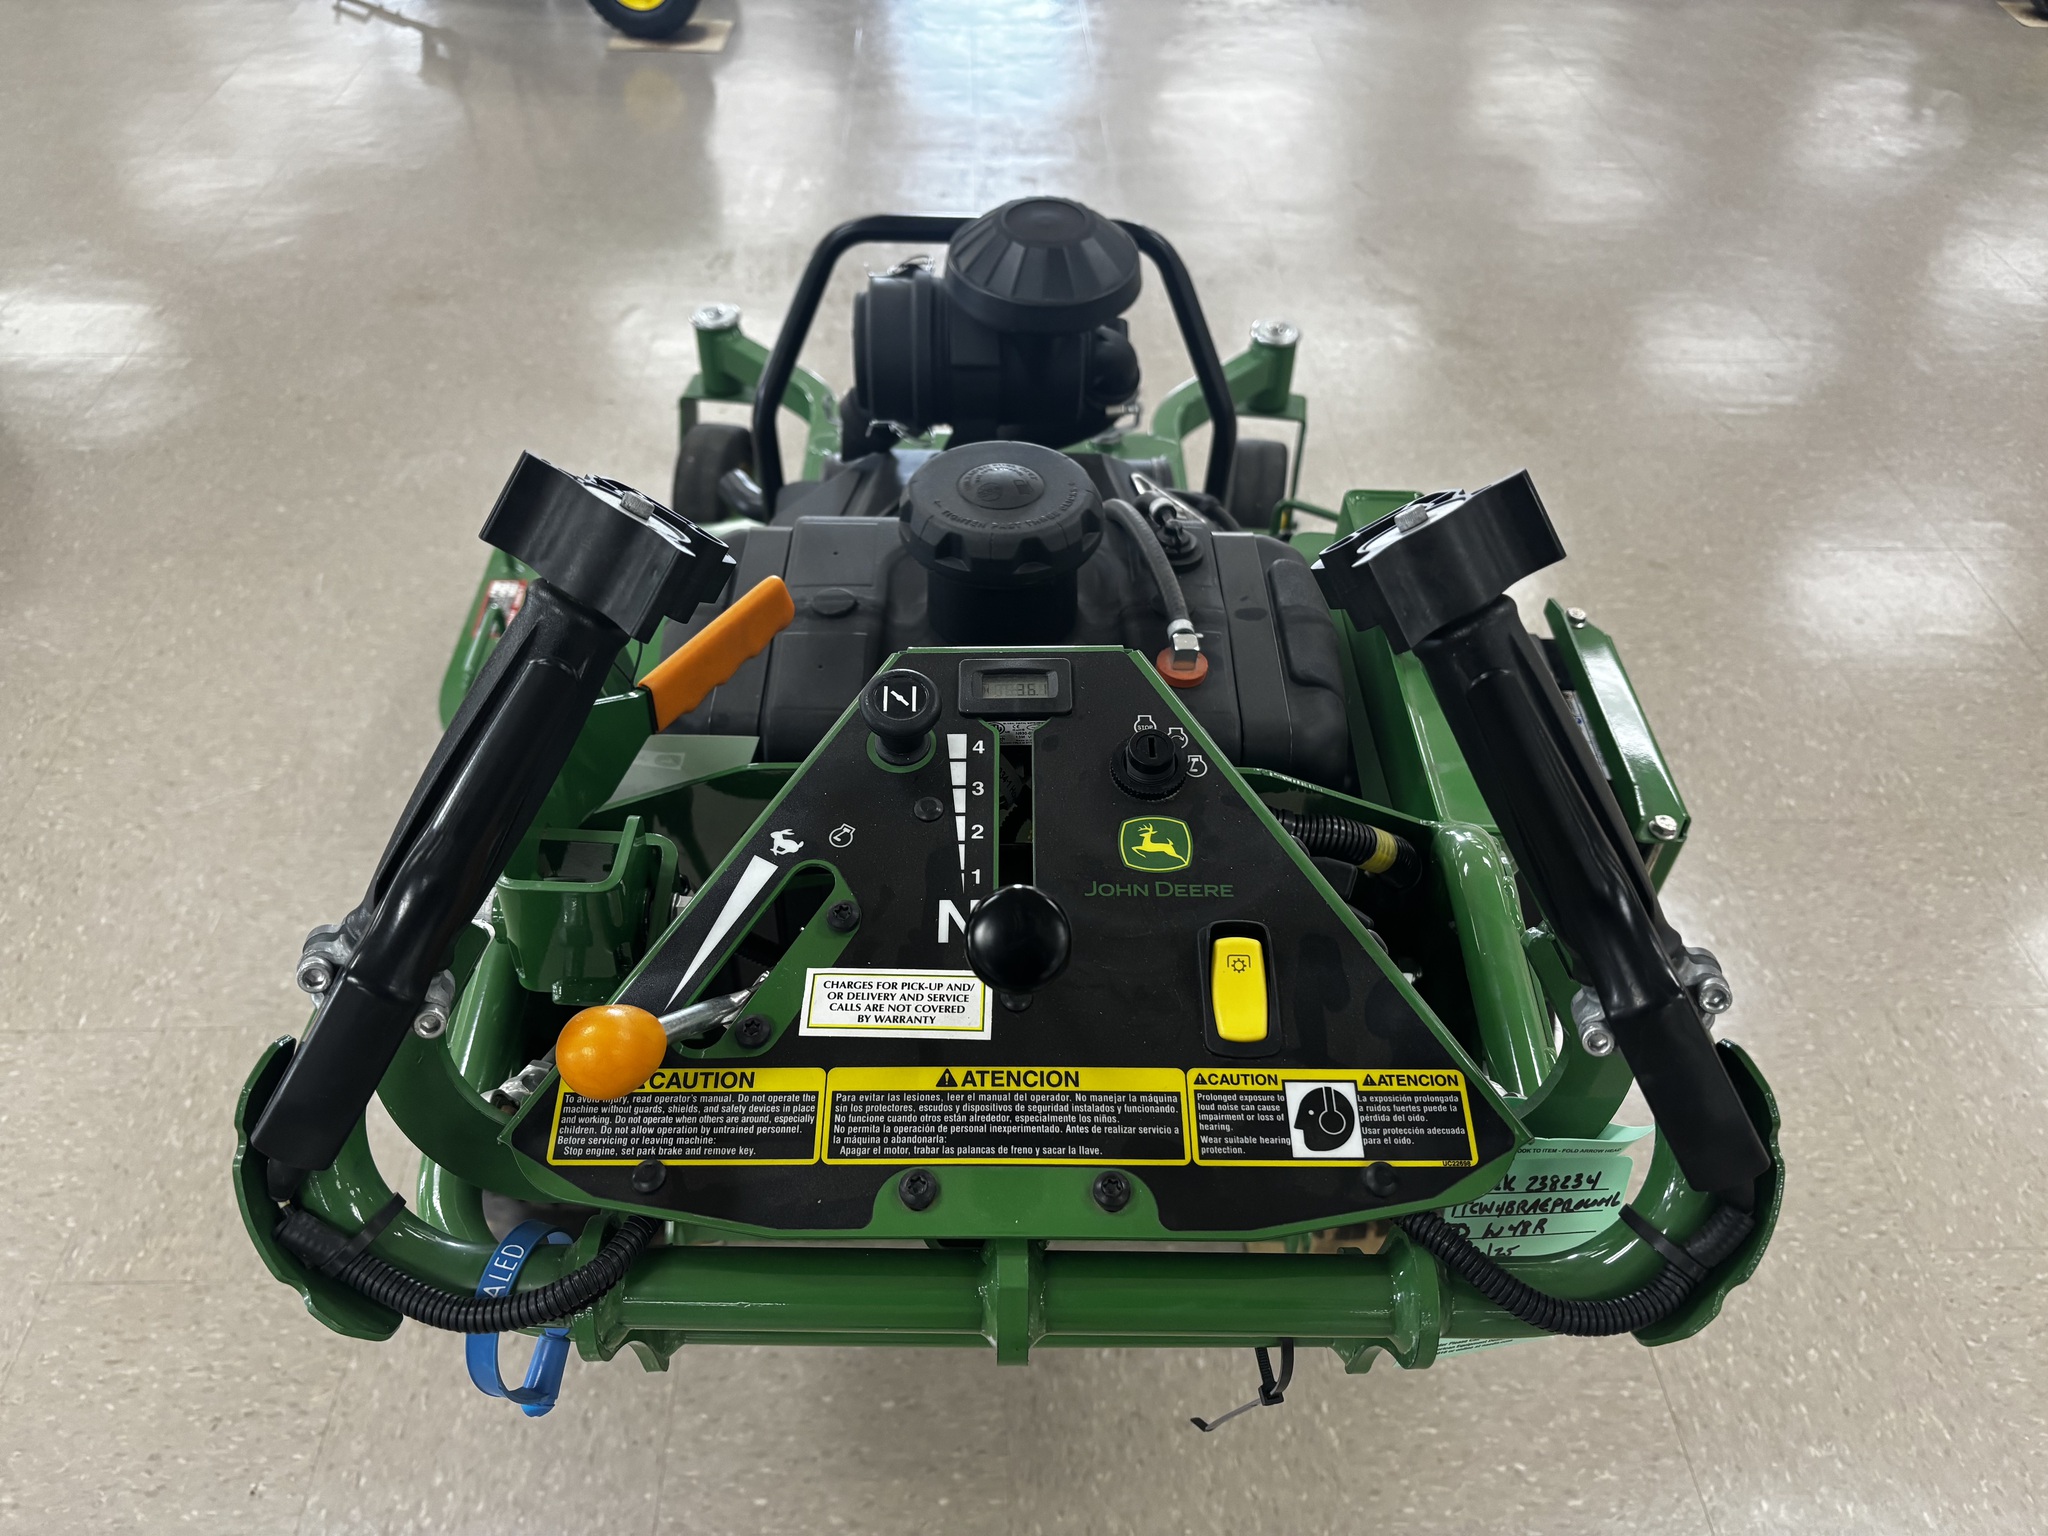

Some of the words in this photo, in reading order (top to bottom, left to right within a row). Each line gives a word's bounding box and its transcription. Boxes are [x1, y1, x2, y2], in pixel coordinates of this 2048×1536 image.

[972, 741, 985, 754] 4
[972, 782, 985, 795] 3
[971, 825, 984, 839] 2
[972, 869, 981, 884] 1
[1084, 881, 1148, 897] JOHN
[1155, 882, 1234, 898] DEERE
[824, 981, 873, 989] CHARGES
[901, 982, 943, 990] PICK-UP
[847, 992, 896, 1000] DELIVERY
[829, 1003, 861, 1011] CALLS
[888, 1004, 911, 1012] NOT
[875, 1015, 936, 1024] WARRANTY
[651, 1072, 755, 1089] CAUTION
[961, 1071, 1079, 1087] ATENCION
[1208, 1074, 1278, 1085] CAUTION
[1378, 1074, 1458, 1086] ATENCION
[566, 1095, 574, 1103] To
[655, 1094, 697, 1104] operator's
[700, 1094, 734, 1103] manual.
[738, 1094, 749, 1102] Do
[752, 1094, 766, 1103] not
[768, 1094, 800, 1104] operate
[803, 1093, 815, 1102] the
[836, 1093, 855, 1101] Para
[859, 1093, 884, 1101] evitar
[888, 1093, 900, 1101] las
[904, 1093, 943, 1104] lesiones,
[947, 1093, 964, 1101] leer
[967, 1093, 975, 1101] el
[979, 1094, 1010, 1104] manual
[1014, 1094, 1027, 1104] del
[1030, 1094, 1072, 1104] operador.
[1075, 1094, 1086, 1102] No
[1090, 1094, 1126, 1105] manejar
[1129, 1094, 1136, 1102] la
[1140, 1094, 1177, 1105] máquina
[1197, 1093, 1236, 1102] Prolonged
[1370, 1095, 1412, 1103] exposición
[1414, 1095, 1458, 1103] prolongada
[601, 1105, 632, 1113] without
[634, 1105, 664, 1115] guards,
[668, 1105, 700, 1113] shields,
[704, 1104, 719, 1112] and
[721, 1104, 746, 1114] safety
[749, 1104, 780, 1112] devices
[783, 1104, 790, 1112] in
[793, 1104, 815, 1114] place
[835, 1104, 847, 1112] sin
[851, 1104, 863, 1112] los
[866, 1104, 915, 1113] protectores,
[919, 1103, 952, 1111] escudos
[956, 1105, 960, 1114] y
[963, 1104, 1012, 1114] dispositivos
[1028, 1104, 1068, 1114] seguridad
[1072, 1104, 1114, 1112] instalados
[1117, 1106, 1121, 1114] y
[1124, 1104, 1178, 1112] funcionando.
[578, 1116, 612, 1125] working.
[615, 1115, 626, 1123] Do
[643, 1115, 673, 1125] operate
[676, 1115, 696, 1123] when
[699, 1115, 724, 1123] others
[741, 1114, 771, 1125] around,
[774, 1114, 814, 1125] especially
[835, 1114, 846, 1122] No
[849, 1114, 884, 1122] funcione
[887, 1114, 917, 1122] cuando
[920, 1114, 942, 1123] otros
[970, 1114, 1011, 1124] alrededor,
[1015, 1114, 1076, 1124] especialmente
[1079, 1114, 1091, 1122] los
[1094, 1114, 1119, 1123] niños.
[1199, 1113, 1244, 1123] impairment
[559, 1126, 597, 1134] children.
[601, 1125, 612, 1134] Do
[631, 1126, 654, 1134] allow
[657, 1125, 698, 1135] operation
[701, 1125, 710, 1135] by
[713, 1125, 754, 1133] untrained
[757, 1125, 802, 1135] personnel.
[1199, 1123, 1233, 1132] hearing.
[1383, 1127, 1424, 1135] protección
[558, 1136, 585, 1145] Before
[588, 1136, 628, 1146] servicing
[642, 1136, 673, 1146] leaving
[833, 1135, 840, 1144] la
[844, 1135, 880, 1145] máquina
[891, 1135, 946, 1144] abandonarla:
[1260, 1136, 1290, 1145] hearing
[564, 1147, 583, 1156] Stop
[586, 1147, 617, 1157] engine,
[621, 1147, 634, 1155] set
[637, 1147, 656, 1157] park
[658, 1147, 682, 1155] brake
[739, 1147, 755, 1156] key.
[1201, 1146, 1245, 1155] protection.
[1526, 1171, 1602, 1192] 238234
[483, 1244, 524, 1298] ALED
